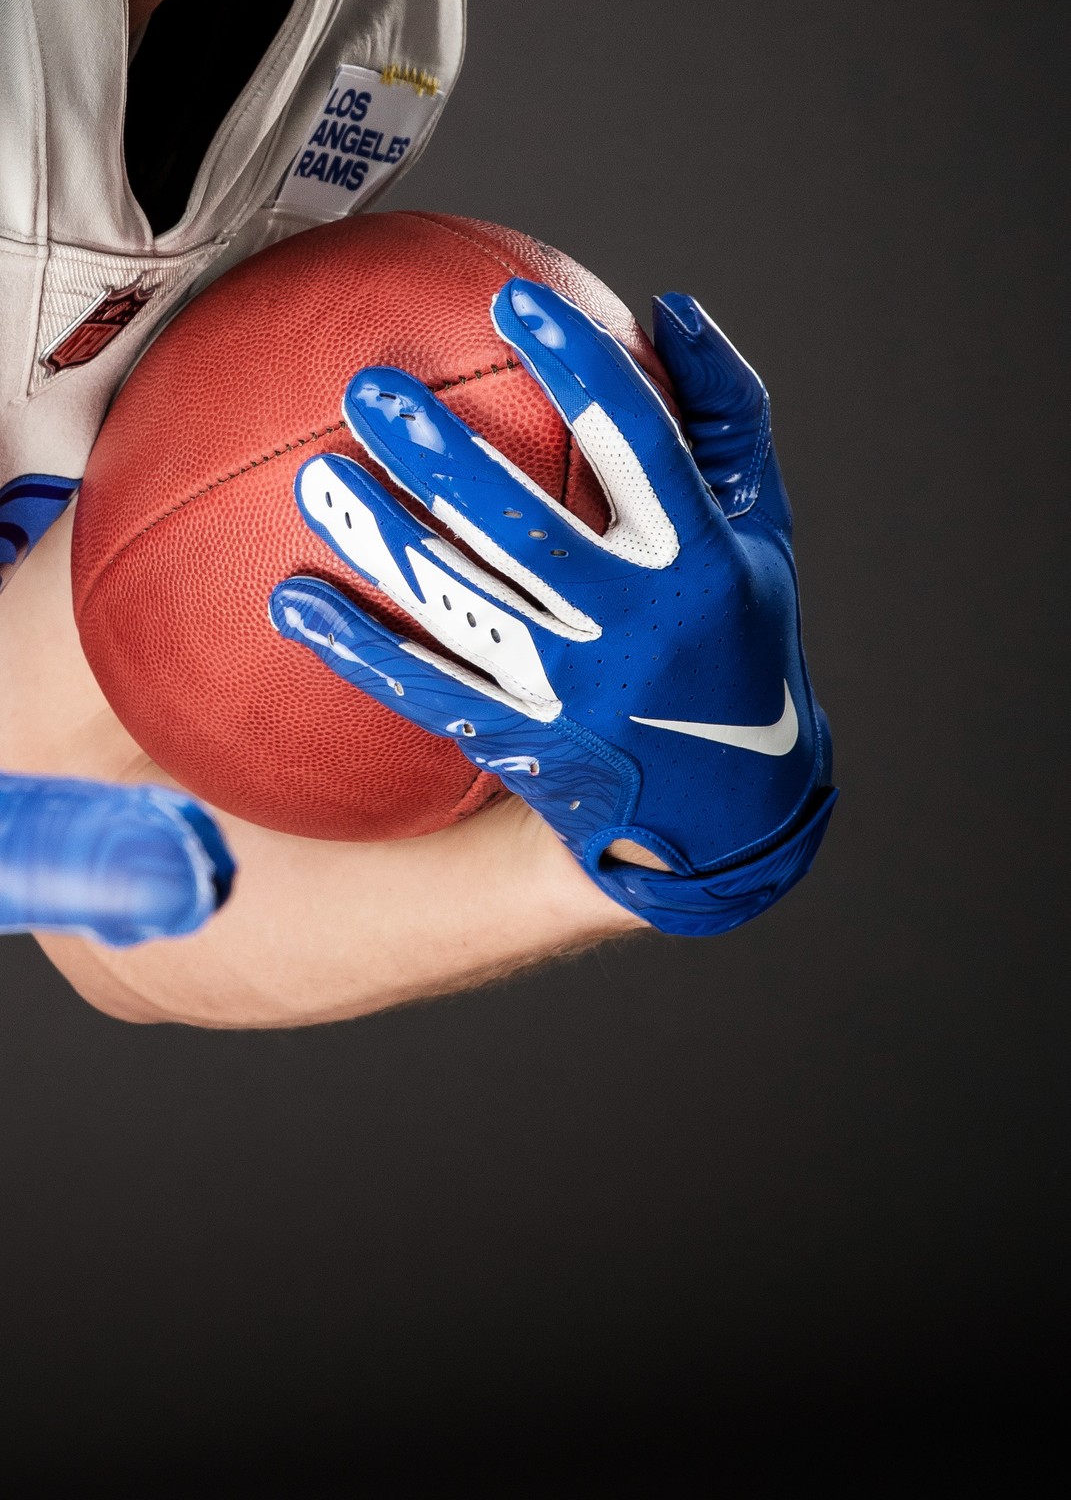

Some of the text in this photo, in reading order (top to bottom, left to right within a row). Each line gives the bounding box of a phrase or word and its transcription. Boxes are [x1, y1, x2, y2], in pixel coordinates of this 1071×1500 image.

[324, 87, 372, 122] LOS
[308, 118, 411, 165] ANGELES
[294, 150, 369, 192] RAMS
